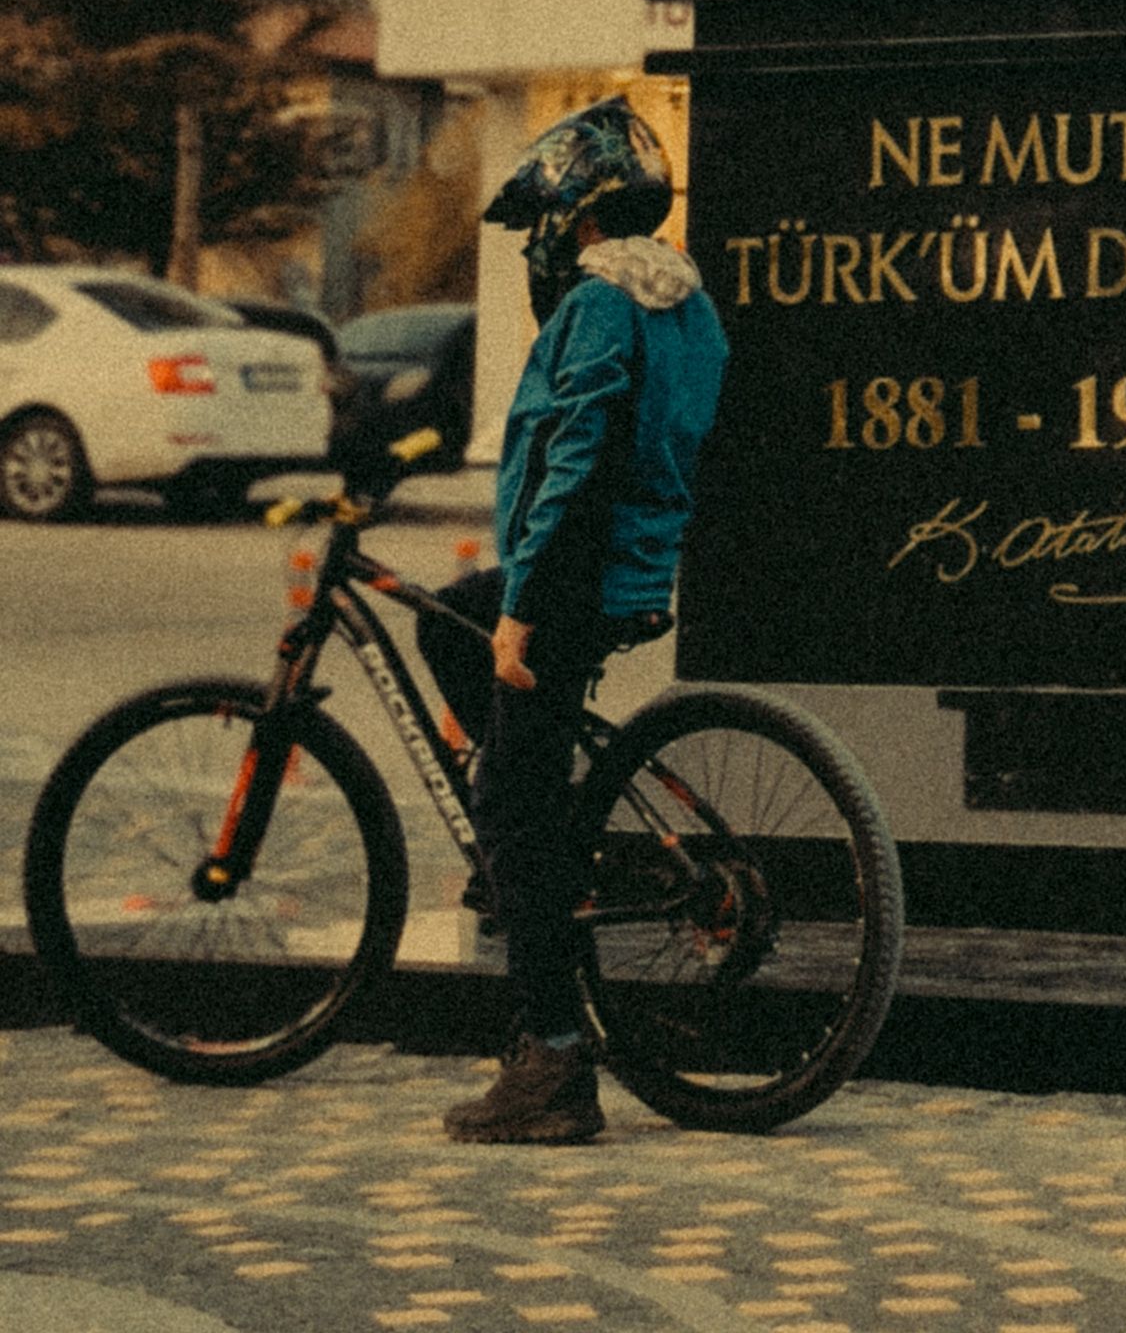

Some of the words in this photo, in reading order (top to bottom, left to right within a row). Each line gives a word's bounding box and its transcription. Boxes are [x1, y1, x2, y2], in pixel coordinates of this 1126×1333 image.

[869, 116, 963, 187] NE
[726, 214, 1067, 305] TÜRK'ÜM
[823, 376, 985, 450] 1881
[1017, 413, 1042, 431] -
[361, 641, 477, 844] ROCKRIDER
